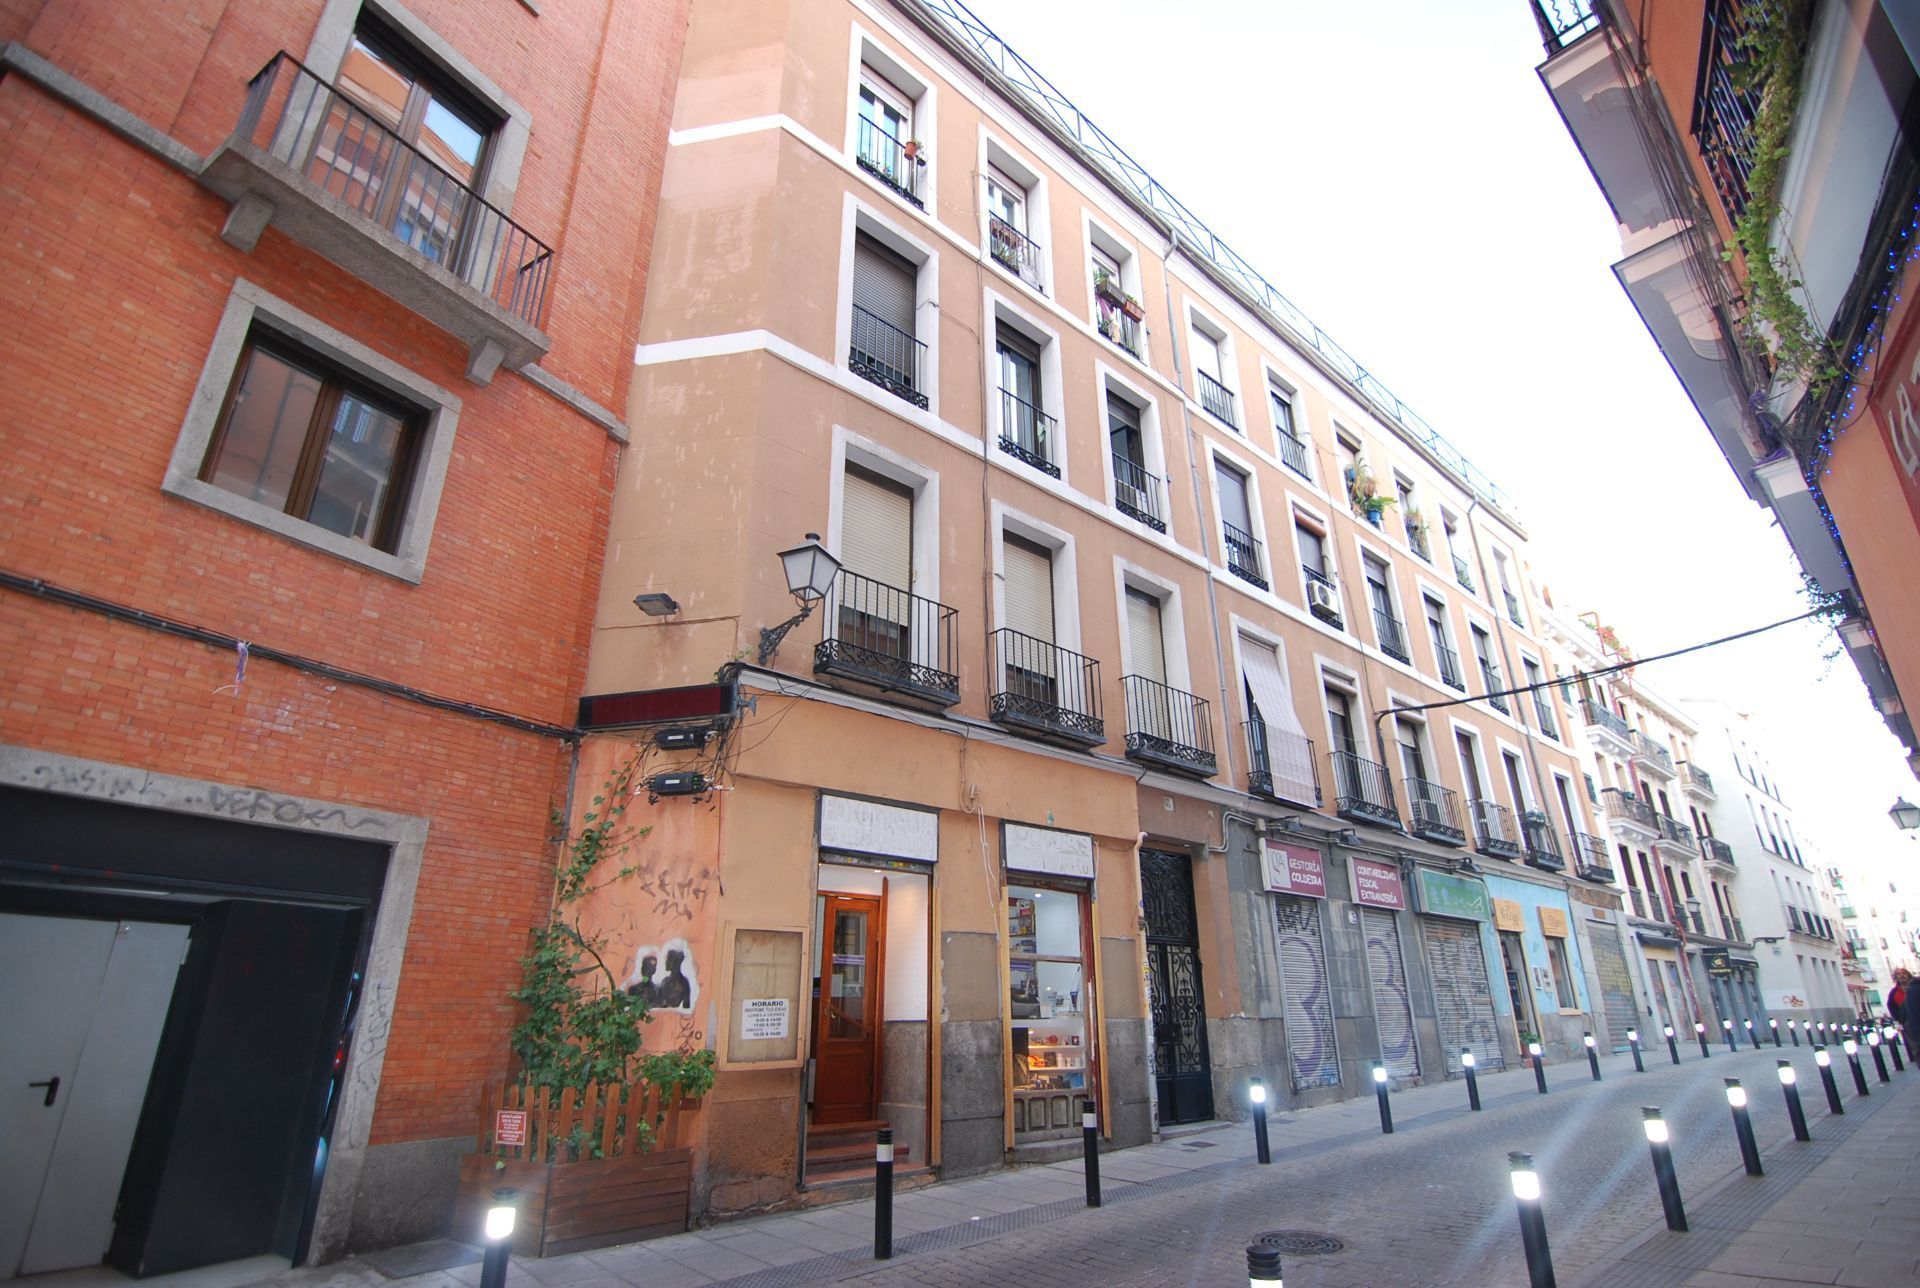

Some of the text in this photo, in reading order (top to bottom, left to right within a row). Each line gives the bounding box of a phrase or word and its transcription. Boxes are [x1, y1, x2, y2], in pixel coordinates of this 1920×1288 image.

[1289, 858, 1320, 872] GESTORÍA
[1291, 872, 1322, 886] COLDEIRA
[1357, 866, 1396, 881] CONTABILIDAD
[1358, 877, 1379, 889] FISCAL
